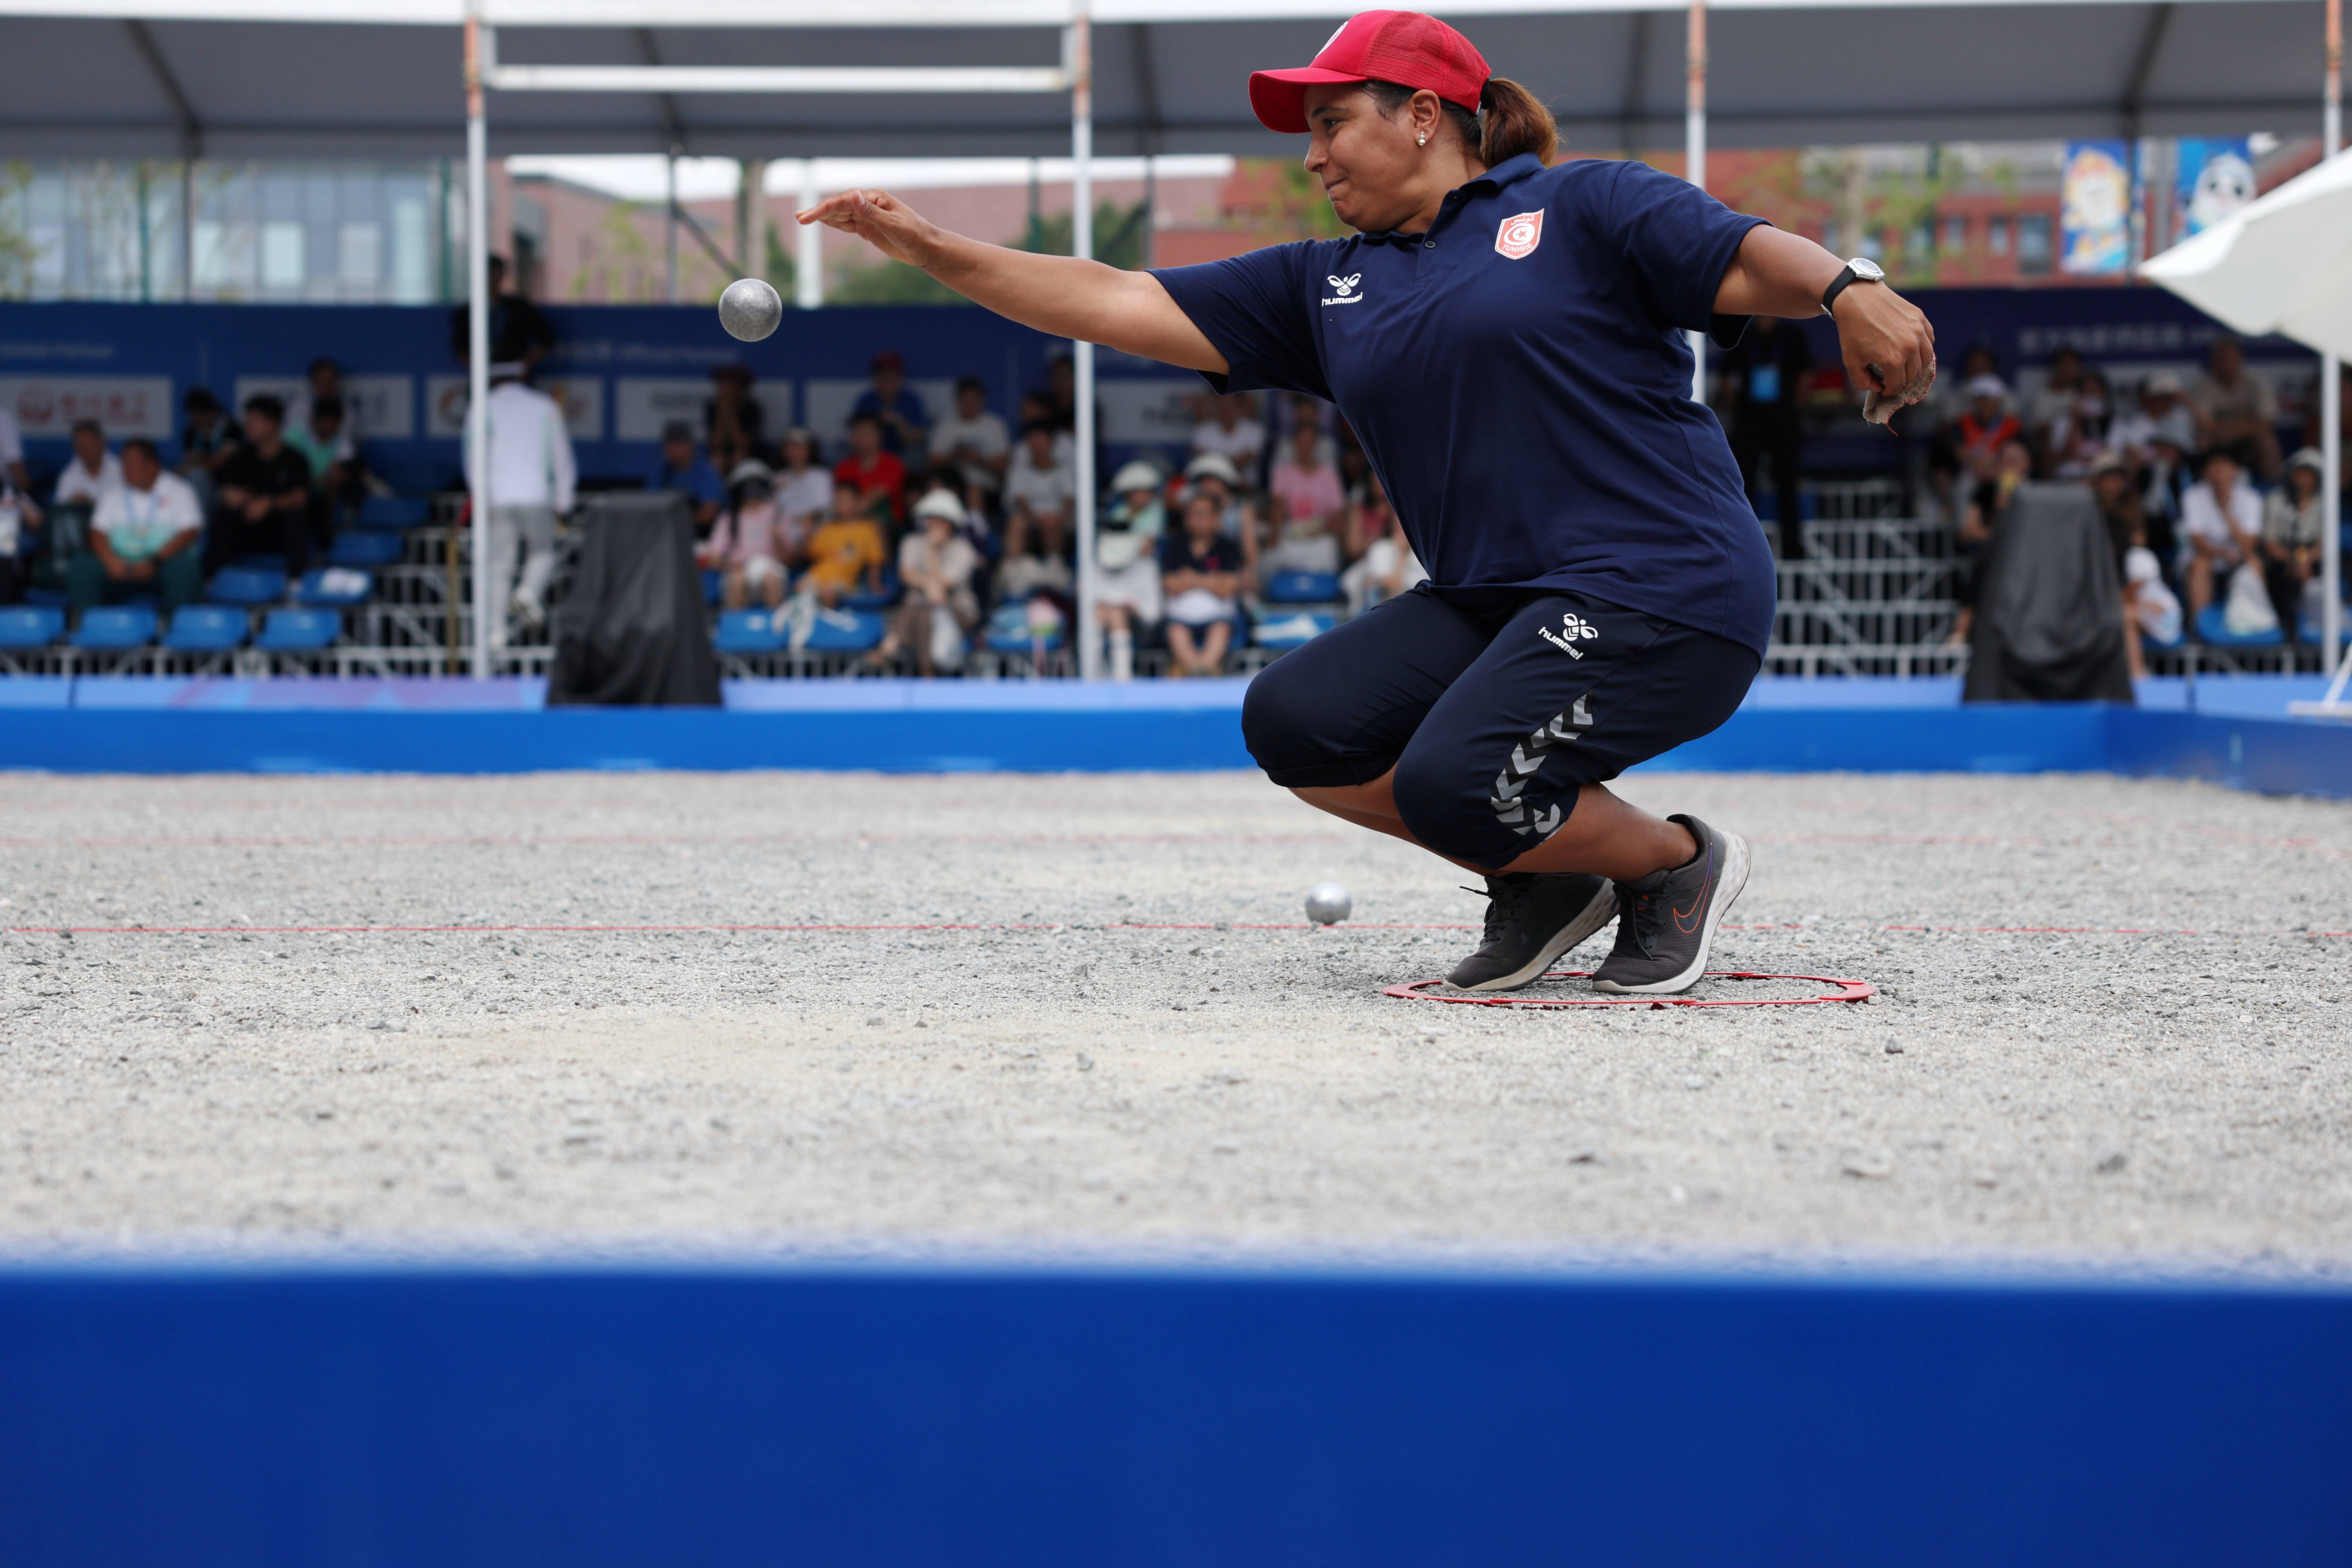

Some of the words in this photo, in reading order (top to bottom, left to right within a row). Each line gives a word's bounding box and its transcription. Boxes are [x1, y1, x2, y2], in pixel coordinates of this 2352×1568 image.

[1510, 215, 1534, 225] تونس
[1502, 242, 1534, 252] TUNISIE
[1321, 291, 1363, 307] hummel
[1538, 626, 1584, 660] hummel
